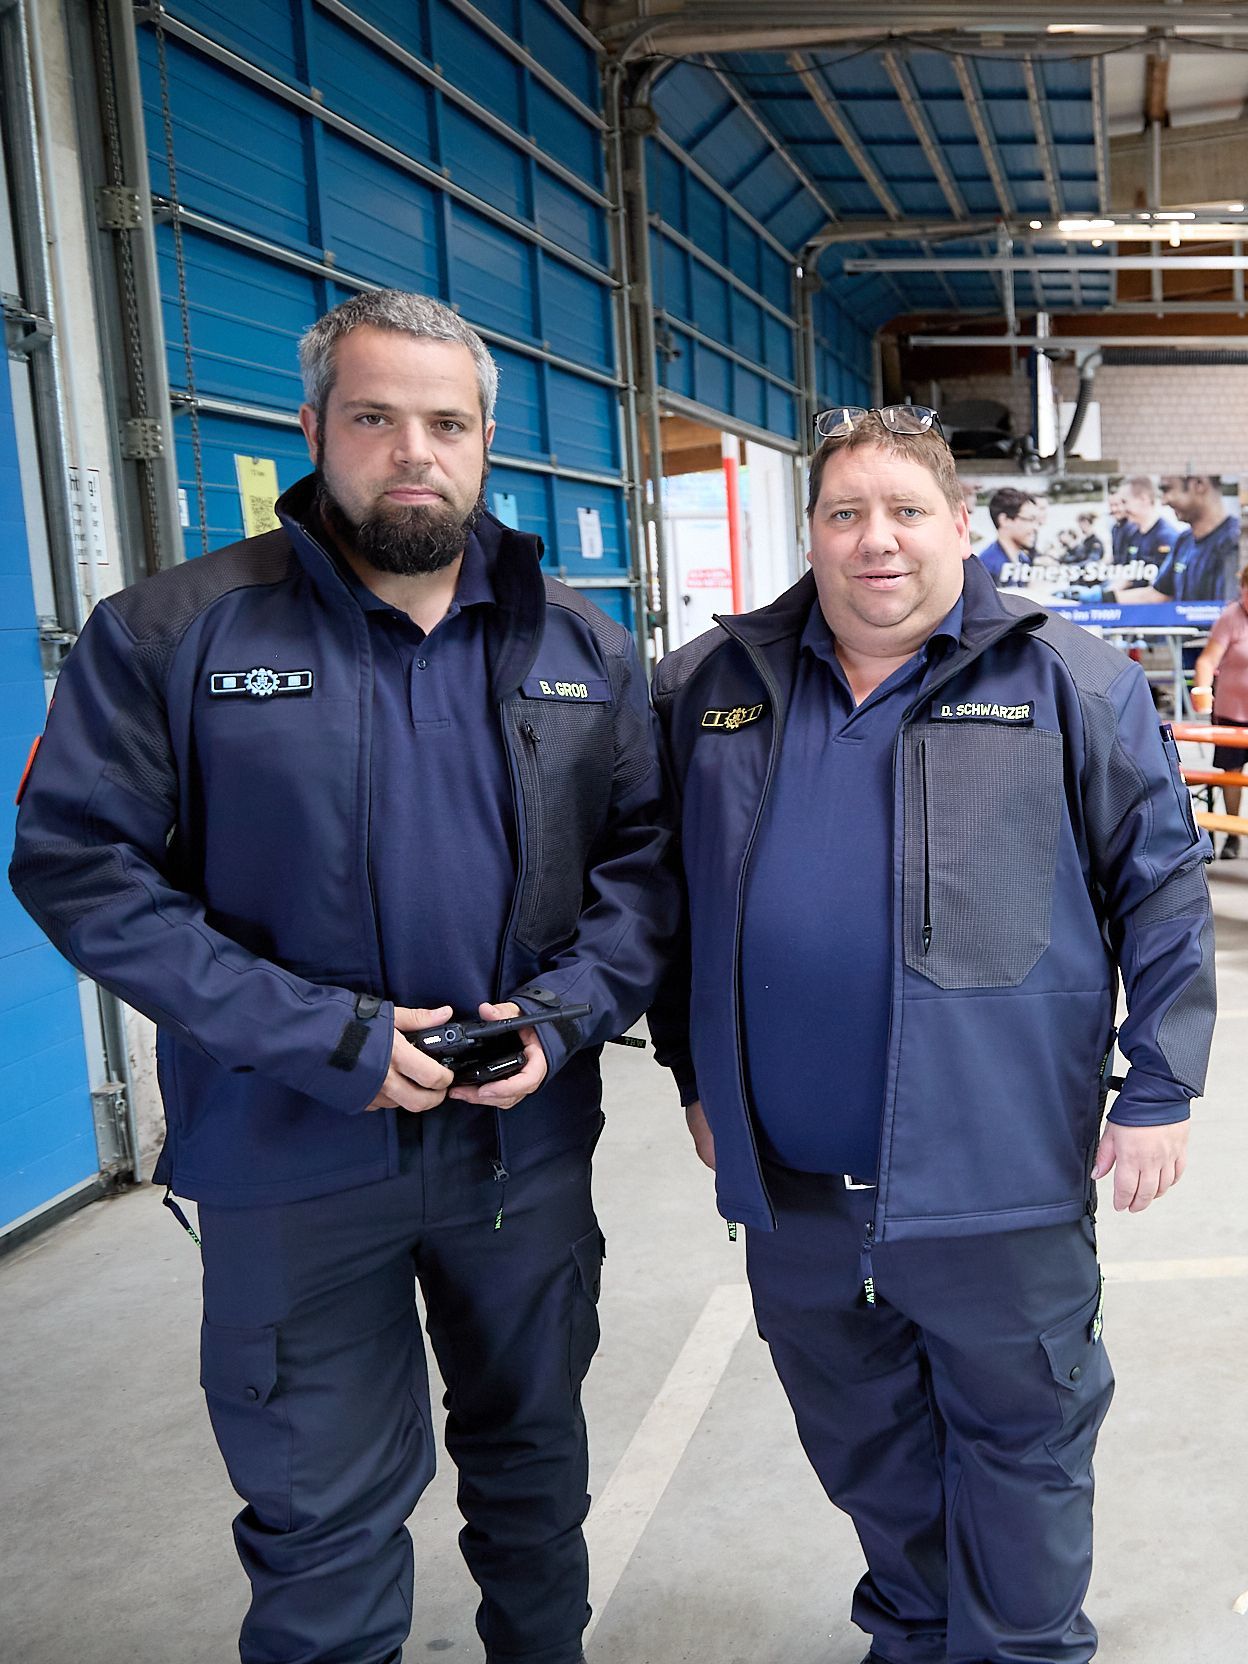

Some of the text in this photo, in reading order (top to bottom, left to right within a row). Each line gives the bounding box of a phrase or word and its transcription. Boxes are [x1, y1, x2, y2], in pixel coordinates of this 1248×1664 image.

[999, 560, 1160, 583] Fitness-Studio
[539, 680, 555, 695] B.
[941, 702, 1030, 720] D. SCHWARZER
[624, 1037, 644, 1047] THW
[727, 1221, 737, 1239] HW
[864, 1277, 875, 1304] THW
